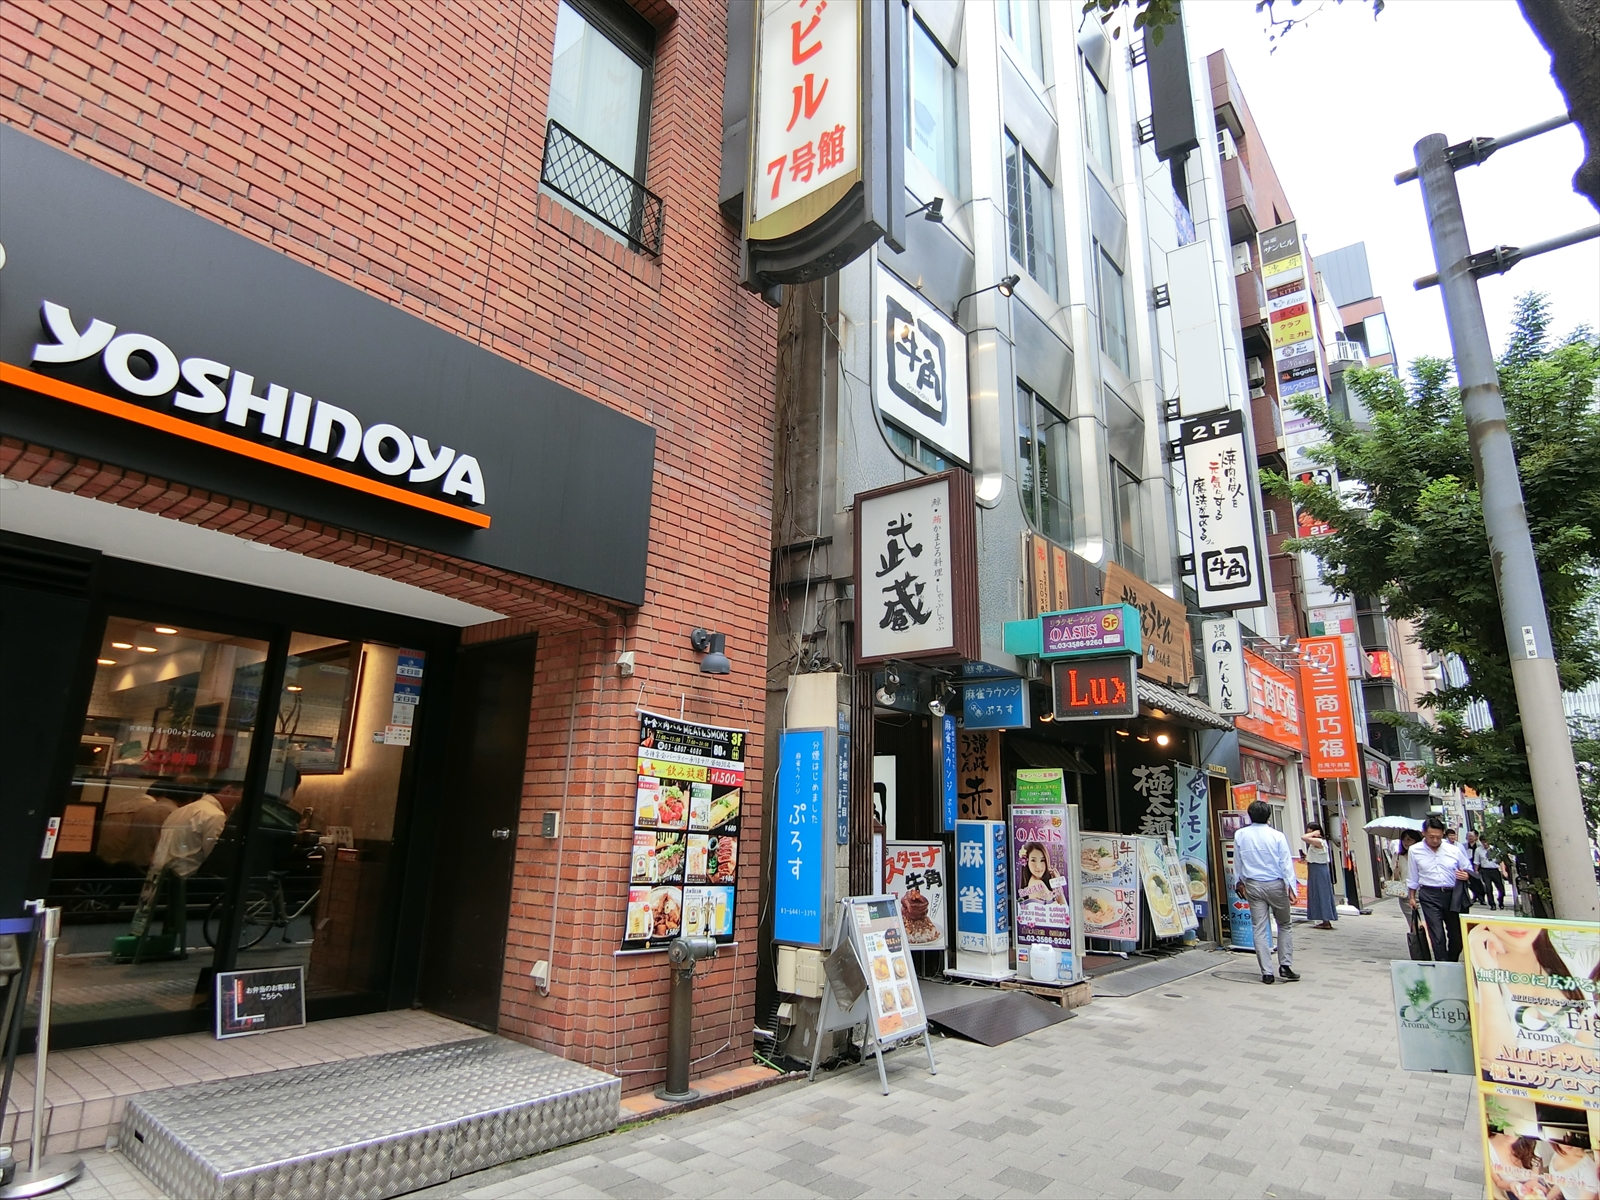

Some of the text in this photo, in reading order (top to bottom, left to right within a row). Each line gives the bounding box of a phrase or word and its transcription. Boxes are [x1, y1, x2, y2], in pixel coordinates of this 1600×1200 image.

[786, 0, 829, 133] ビル
[767, 124, 846, 201] 7号館
[1264, 239, 1296, 255] サンビル
[895, 325, 942, 402] 牛角
[1292, 367, 1317, 377] regalo
[1281, 380, 1318, 391] シルクロード
[32, 300, 486, 505] YOSHINOYA
[1192, 419, 1231, 441] 2F
[1208, 461, 1226, 521] 元気にする
[1310, 525, 1329, 536] 2F
[875, 512, 932, 634] 武蔵
[1209, 557, 1246, 580] 牛角
[1049, 614, 1097, 628] リラクゼーション
[1103, 617, 1118, 629] 5F
[1049, 623, 1098, 642] OASIS
[965, 684, 1020, 701] 麻雀ラウンジ
[1218, 660, 1233, 710] たもん庵
[985, 704, 1014, 716] ぷろす
[1311, 671, 1345, 758] 三商巧福
[683, 725, 729, 742] MEAT&SMOKE
[731, 732, 743, 746] 3F
[945, 718, 953, 792] 麻雀ラウンジ
[665, 764, 705, 782] 飲み放題
[811, 740, 820, 824] 分煙はじめました
[958, 775, 993, 820] 赤
[1131, 764, 1176, 835] 極太麺
[1051, 817, 1062, 826] 5F
[1186, 795, 1202, 852] レモン
[839, 825, 847, 838] 12
[1016, 827, 1062, 843] OASIS
[788, 803, 807, 880] ぷろす
[886, 846, 941, 885] スタミナ
[905, 869, 943, 893] 牛角
[959, 840, 984, 914] 麻雀
[961, 934, 985, 947] ぷろす
[245, 982, 297, 995] お弁当のお客様は
[260, 992, 283, 1001] こちらへ
[1430, 1006, 1467, 1024] Eigh
[1400, 1021, 1430, 1030] Aroma
[1516, 1028, 1561, 1044] Aroma
